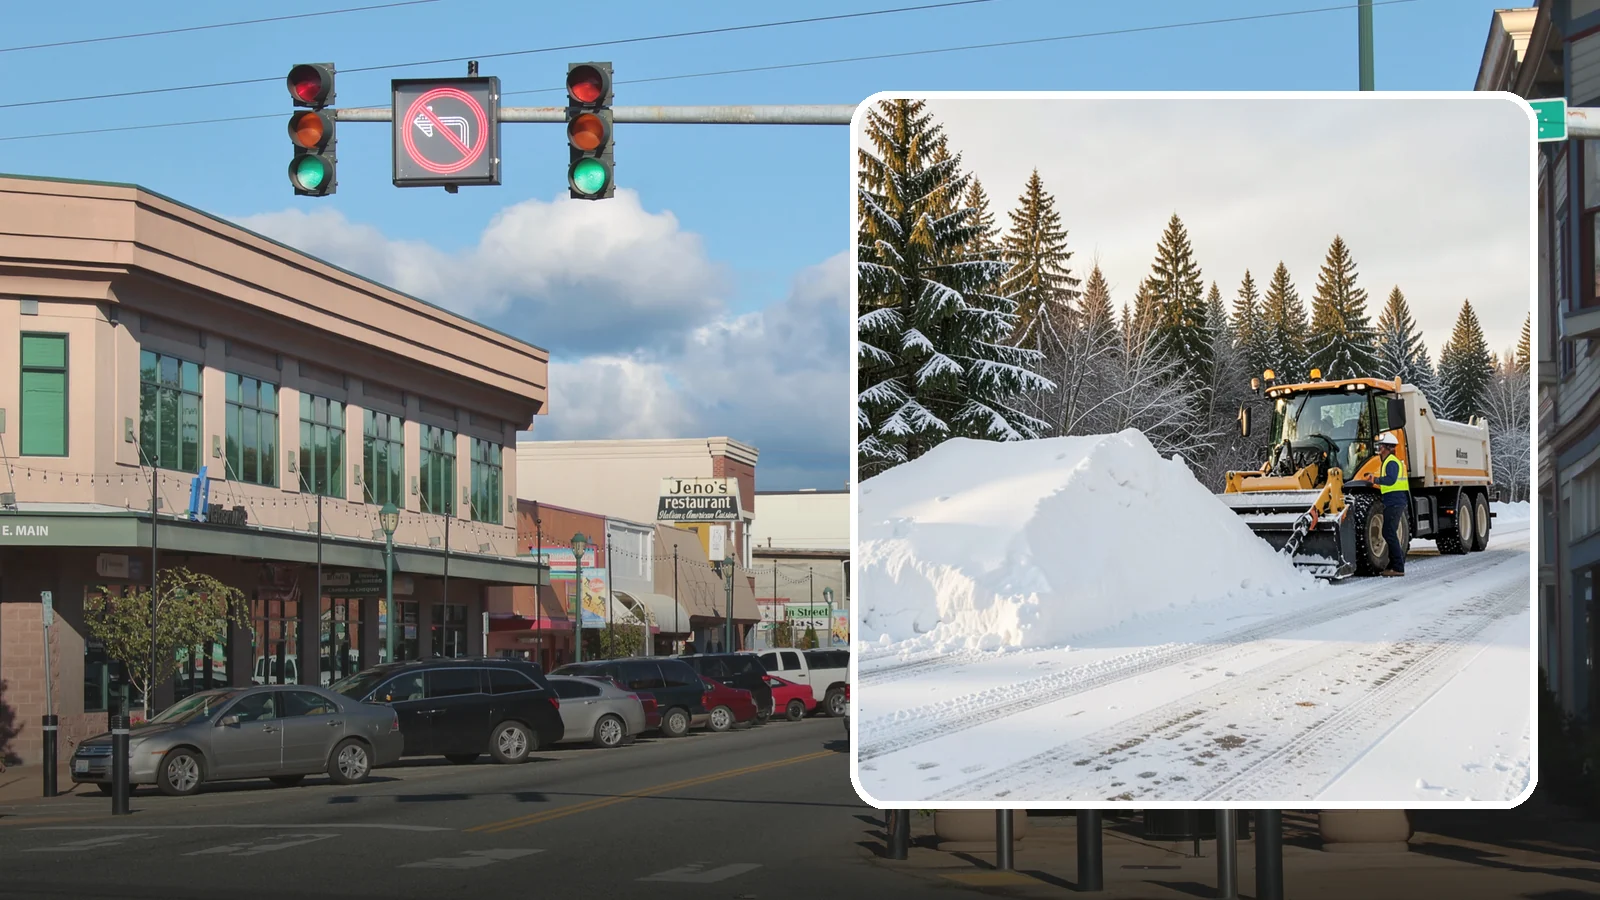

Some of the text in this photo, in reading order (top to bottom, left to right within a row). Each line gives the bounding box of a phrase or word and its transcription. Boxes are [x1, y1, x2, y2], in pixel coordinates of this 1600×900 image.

[669, 480, 728, 495] Jeno's
[665, 496, 731, 509] restaurant
[686, 509, 714, 519] American
[714, 509, 738, 519] Cuisine
[2, 525, 49, 536] E. MAIN
[797, 607, 828, 617] Street
